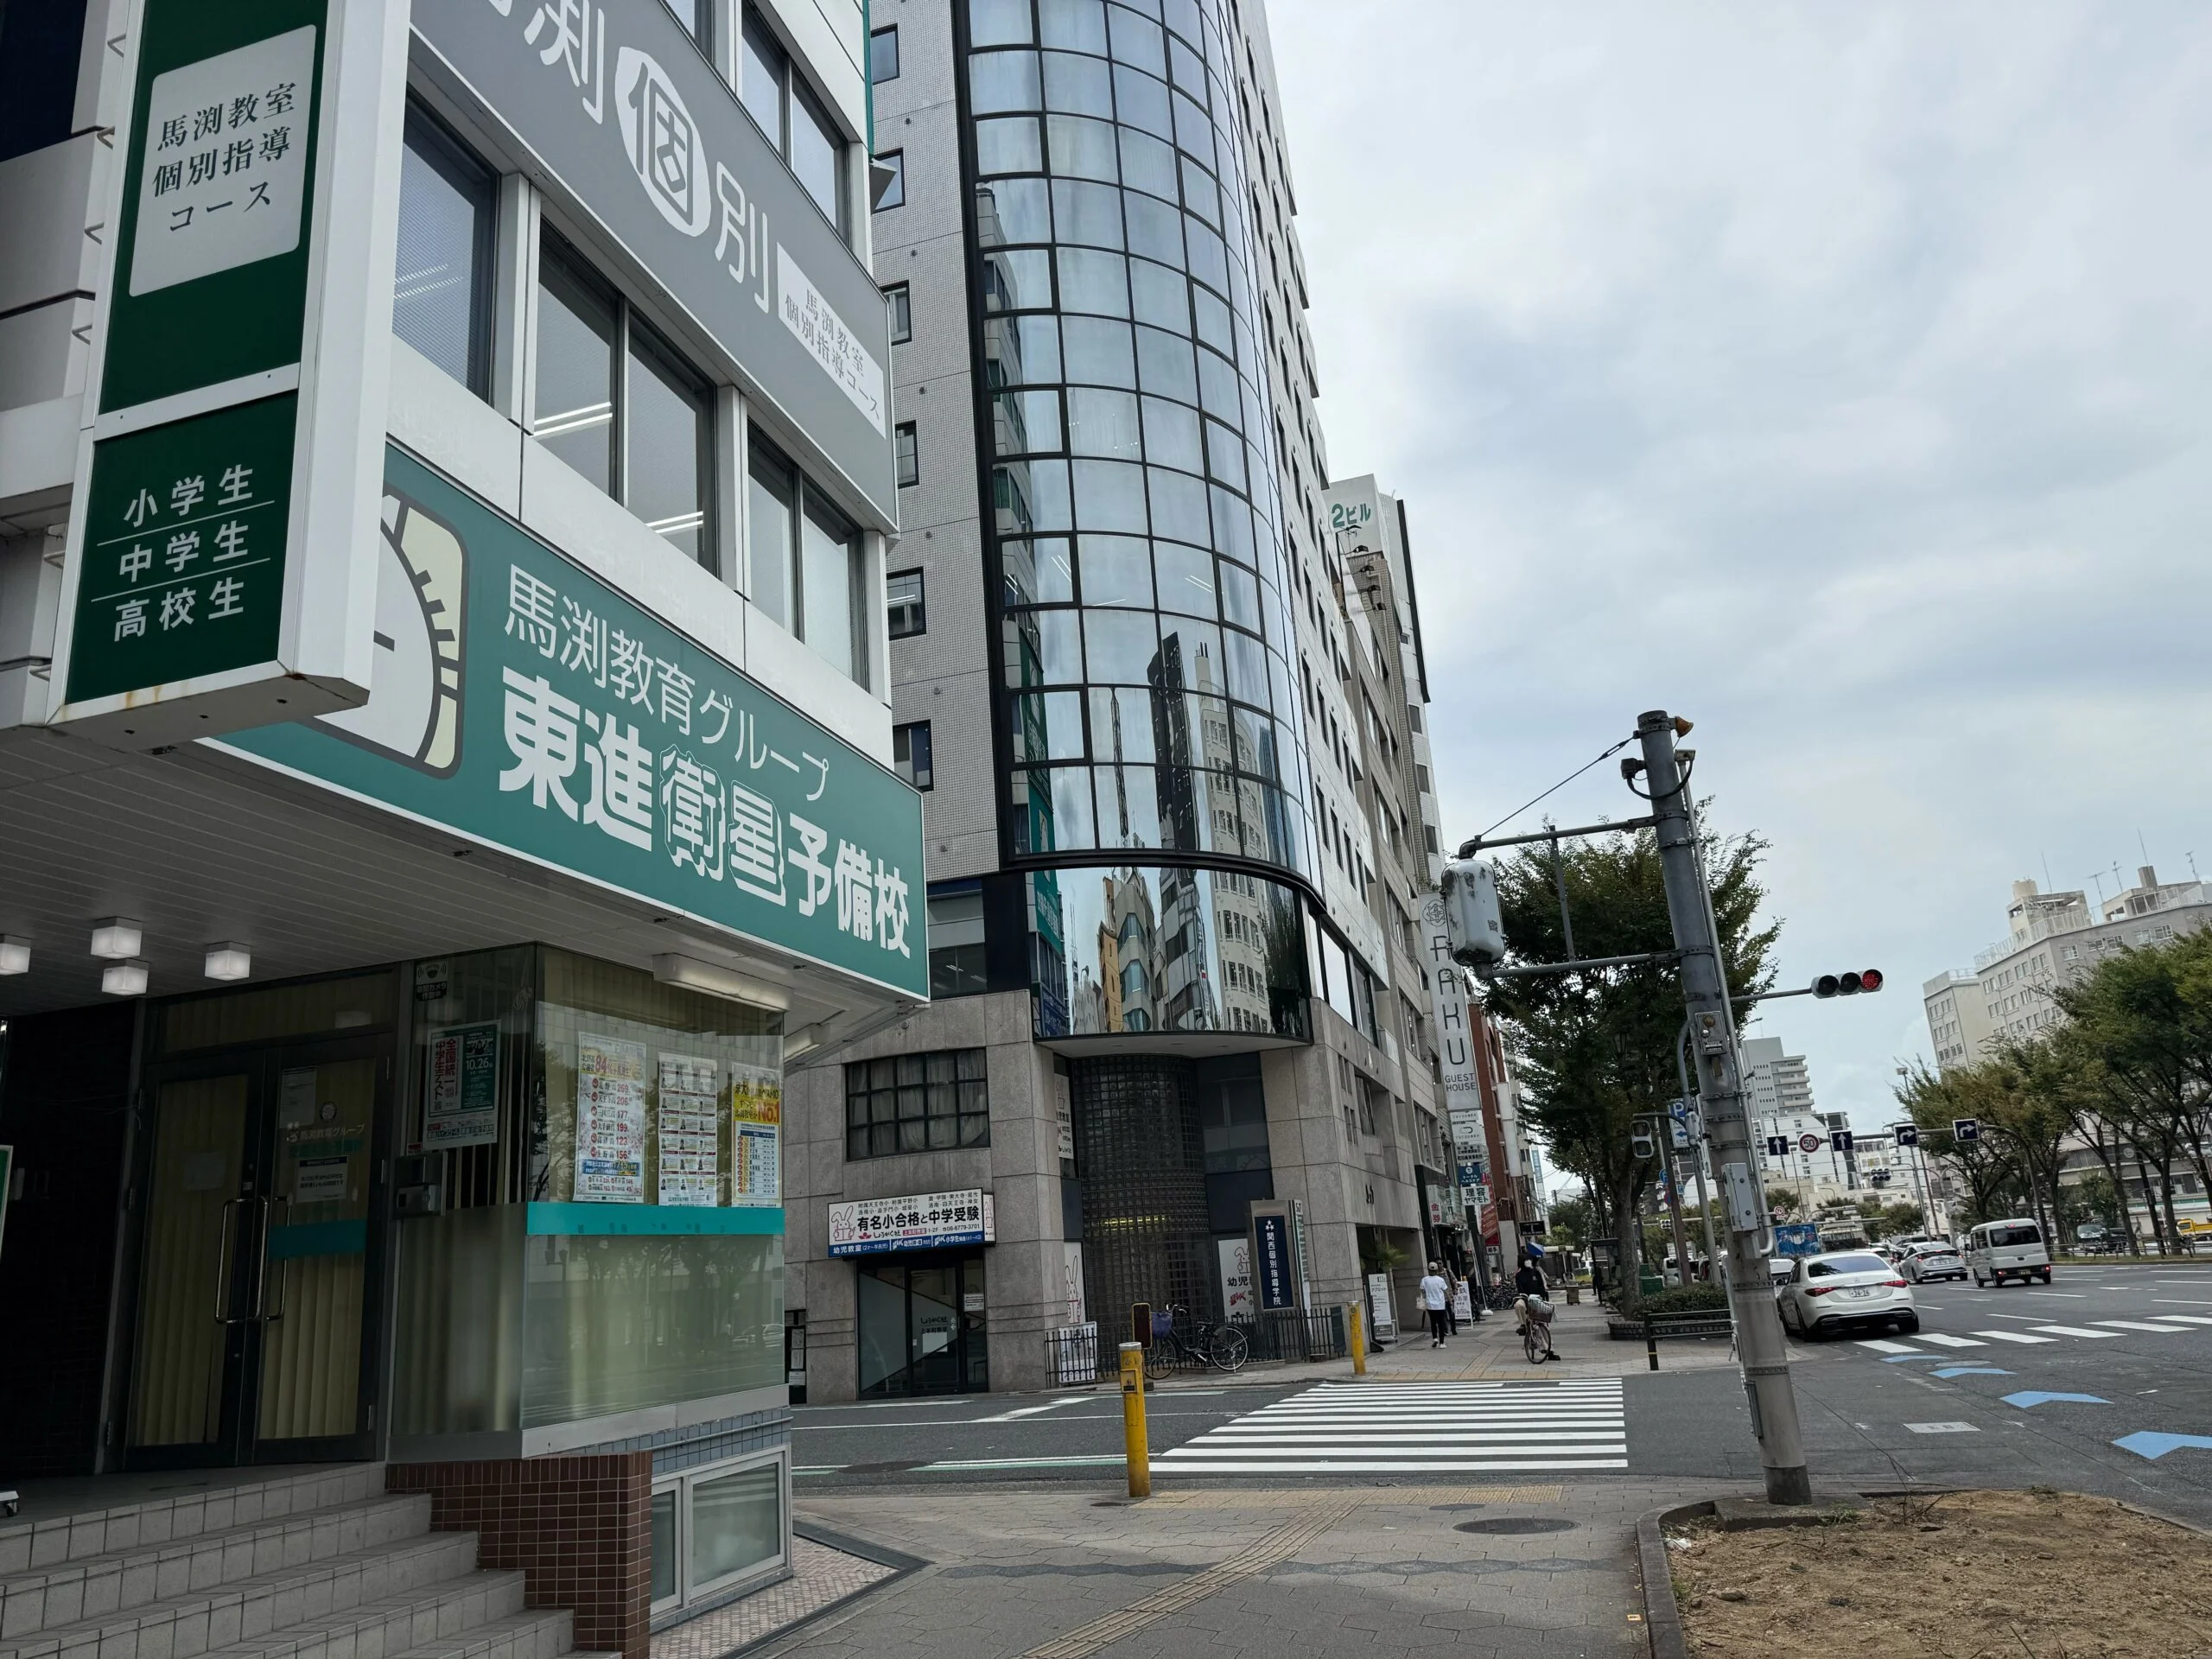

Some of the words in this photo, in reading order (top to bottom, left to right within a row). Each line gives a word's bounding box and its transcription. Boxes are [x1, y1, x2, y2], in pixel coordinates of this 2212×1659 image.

[156, 81, 298, 152] 馬渕教室
[152, 125, 293, 198] 個別指導
[489, 0, 771, 315] 渕個別
[168, 181, 271, 233] コース
[785, 293, 880, 421] 個別指導コース
[804, 288, 865, 378] 馬渕教室
[123, 463, 255, 529] 小学生
[1331, 502, 1371, 528] 2ビル
[118, 519, 251, 584] 中学生
[113, 576, 245, 644] 高校生
[505, 563, 830, 804] 馬渕教育グループ
[499, 666, 912, 960] 東進衛星予備校
[443, 1038, 457, 1084] 全国統一
[465, 1057, 489, 1071] 10.26
[1445, 1073, 1475, 1084] GUEST
[1446, 1082, 1477, 1093] HOUSE
[1803, 1139, 1815, 1147] 50
[857, 1205, 980, 1231] 有名小合格と中学受験
[1465, 1187, 1485, 1197] 理容
[833, 1244, 862, 1254] 幼児教室
[1266, 1232, 1282, 1306] 関西個別指導学院
[1227, 1276, 1252, 1287] 幼児
